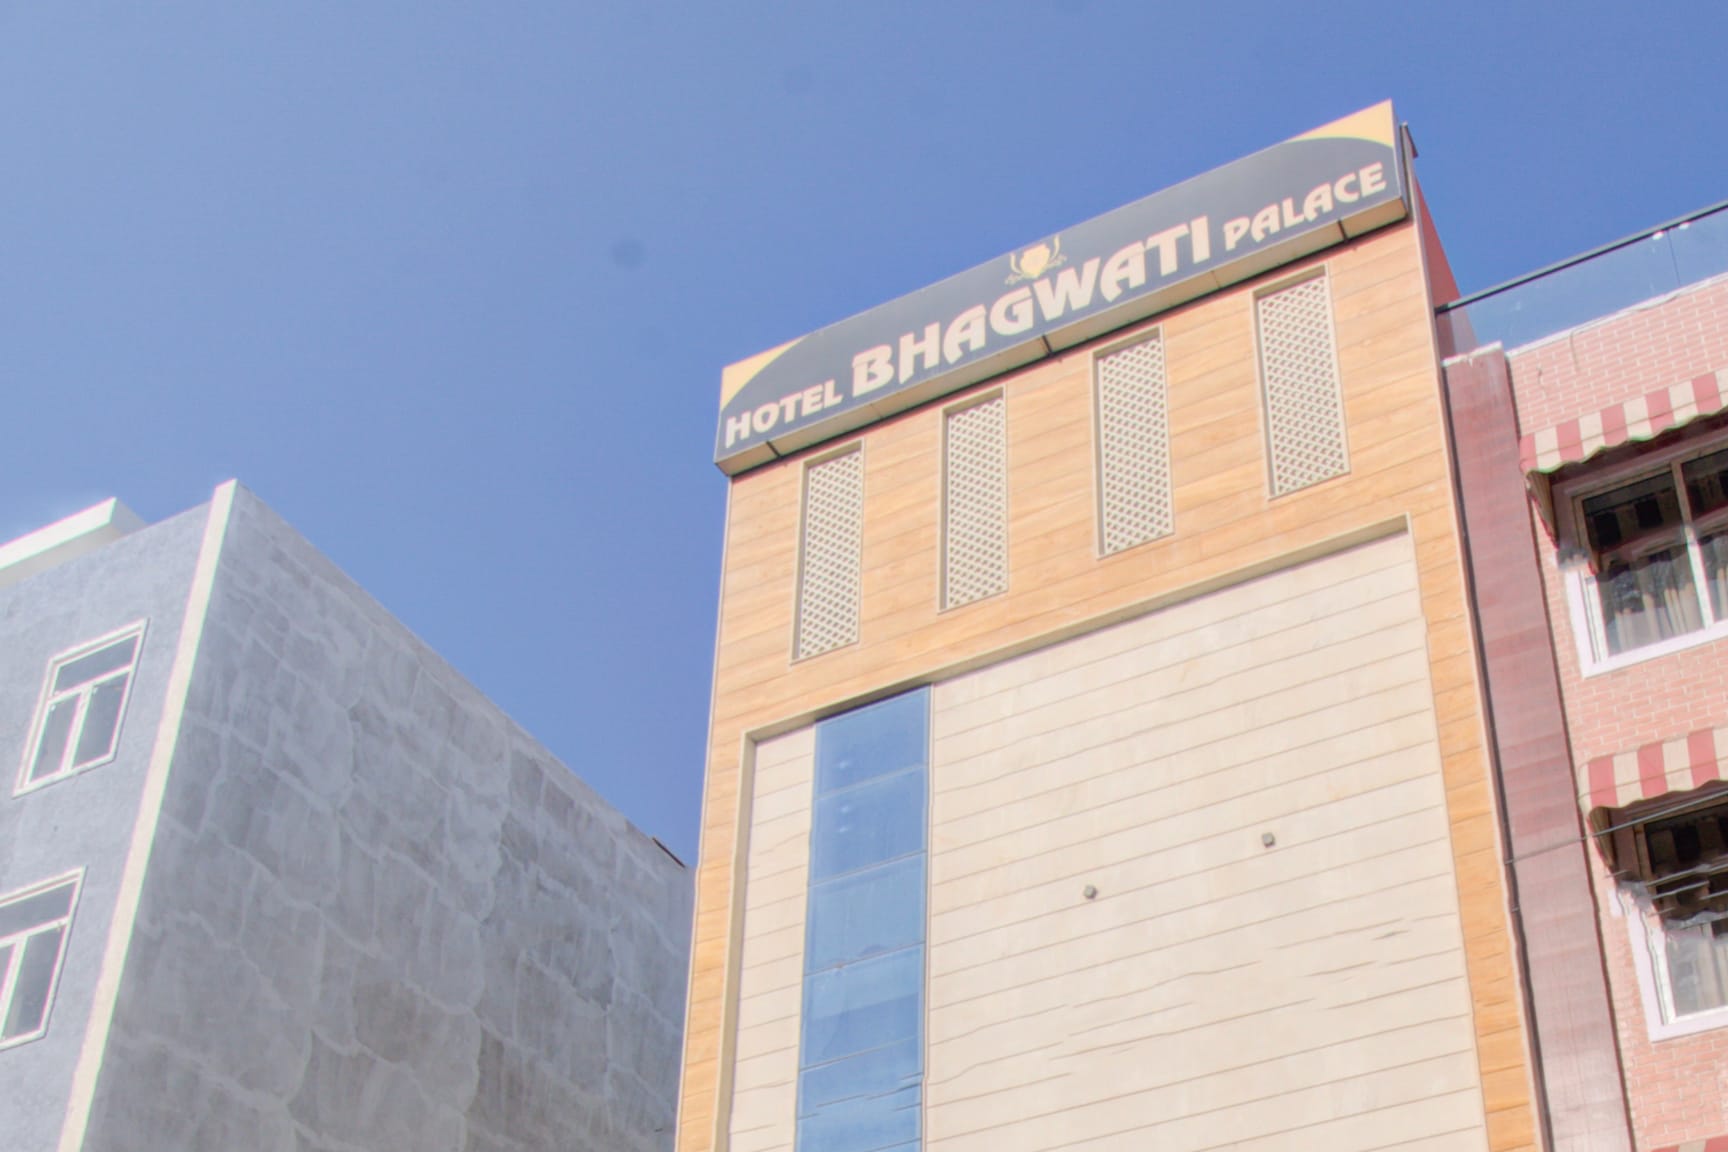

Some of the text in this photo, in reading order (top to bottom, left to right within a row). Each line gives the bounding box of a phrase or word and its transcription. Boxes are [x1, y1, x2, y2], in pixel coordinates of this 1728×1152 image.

[724, 162, 1387, 449] HOTEL BHAGWATI PALACE
